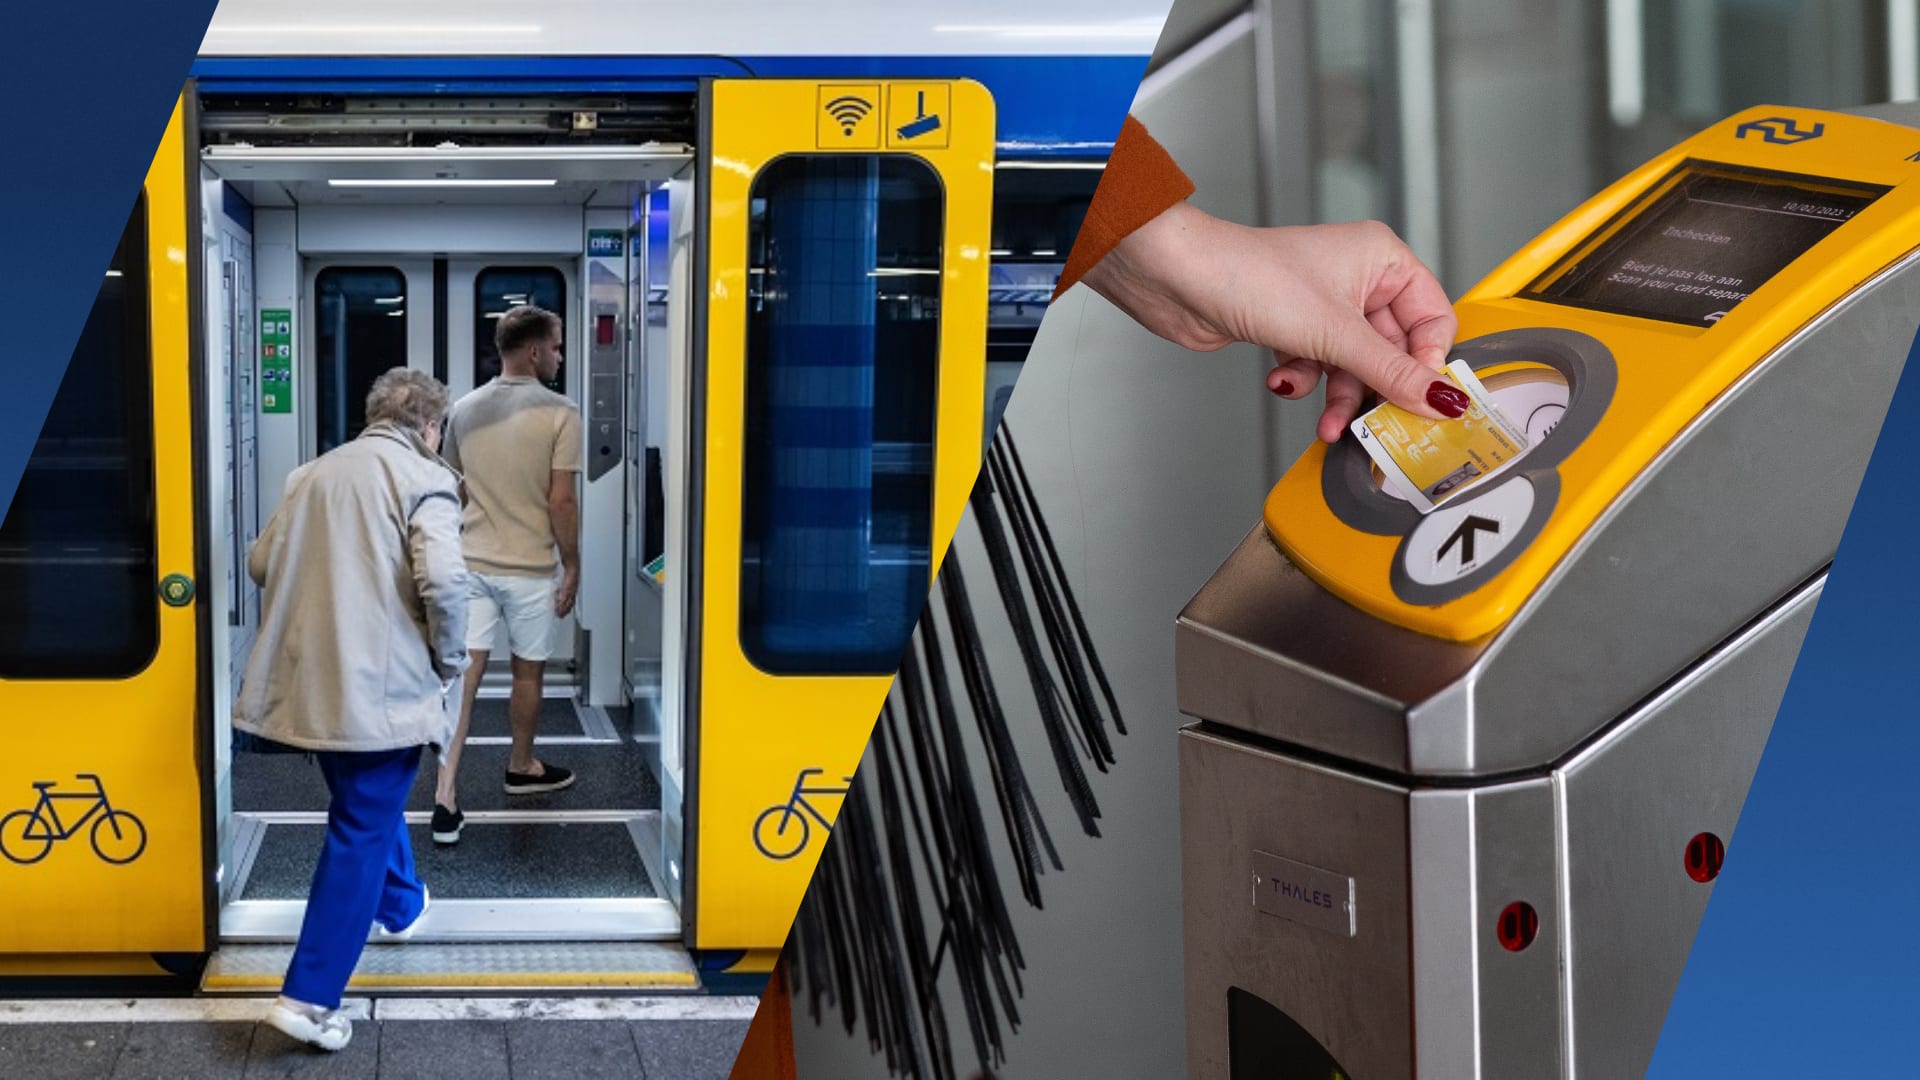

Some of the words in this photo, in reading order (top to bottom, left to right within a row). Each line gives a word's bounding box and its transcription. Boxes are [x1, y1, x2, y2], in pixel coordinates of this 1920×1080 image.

[1662, 226, 1732, 245] Inchecken
[1607, 272, 1643, 285] Scan
[1639, 278, 1675, 289] your
[1674, 283, 1710, 295] card
[1621, 260, 1653, 273] Bied
[1650, 264, 1668, 276] je
[1667, 267, 1694, 280] pas
[1693, 270, 1716, 282] los
[1716, 276, 1743, 287] aan
[1271, 878, 1333, 909] THALES
